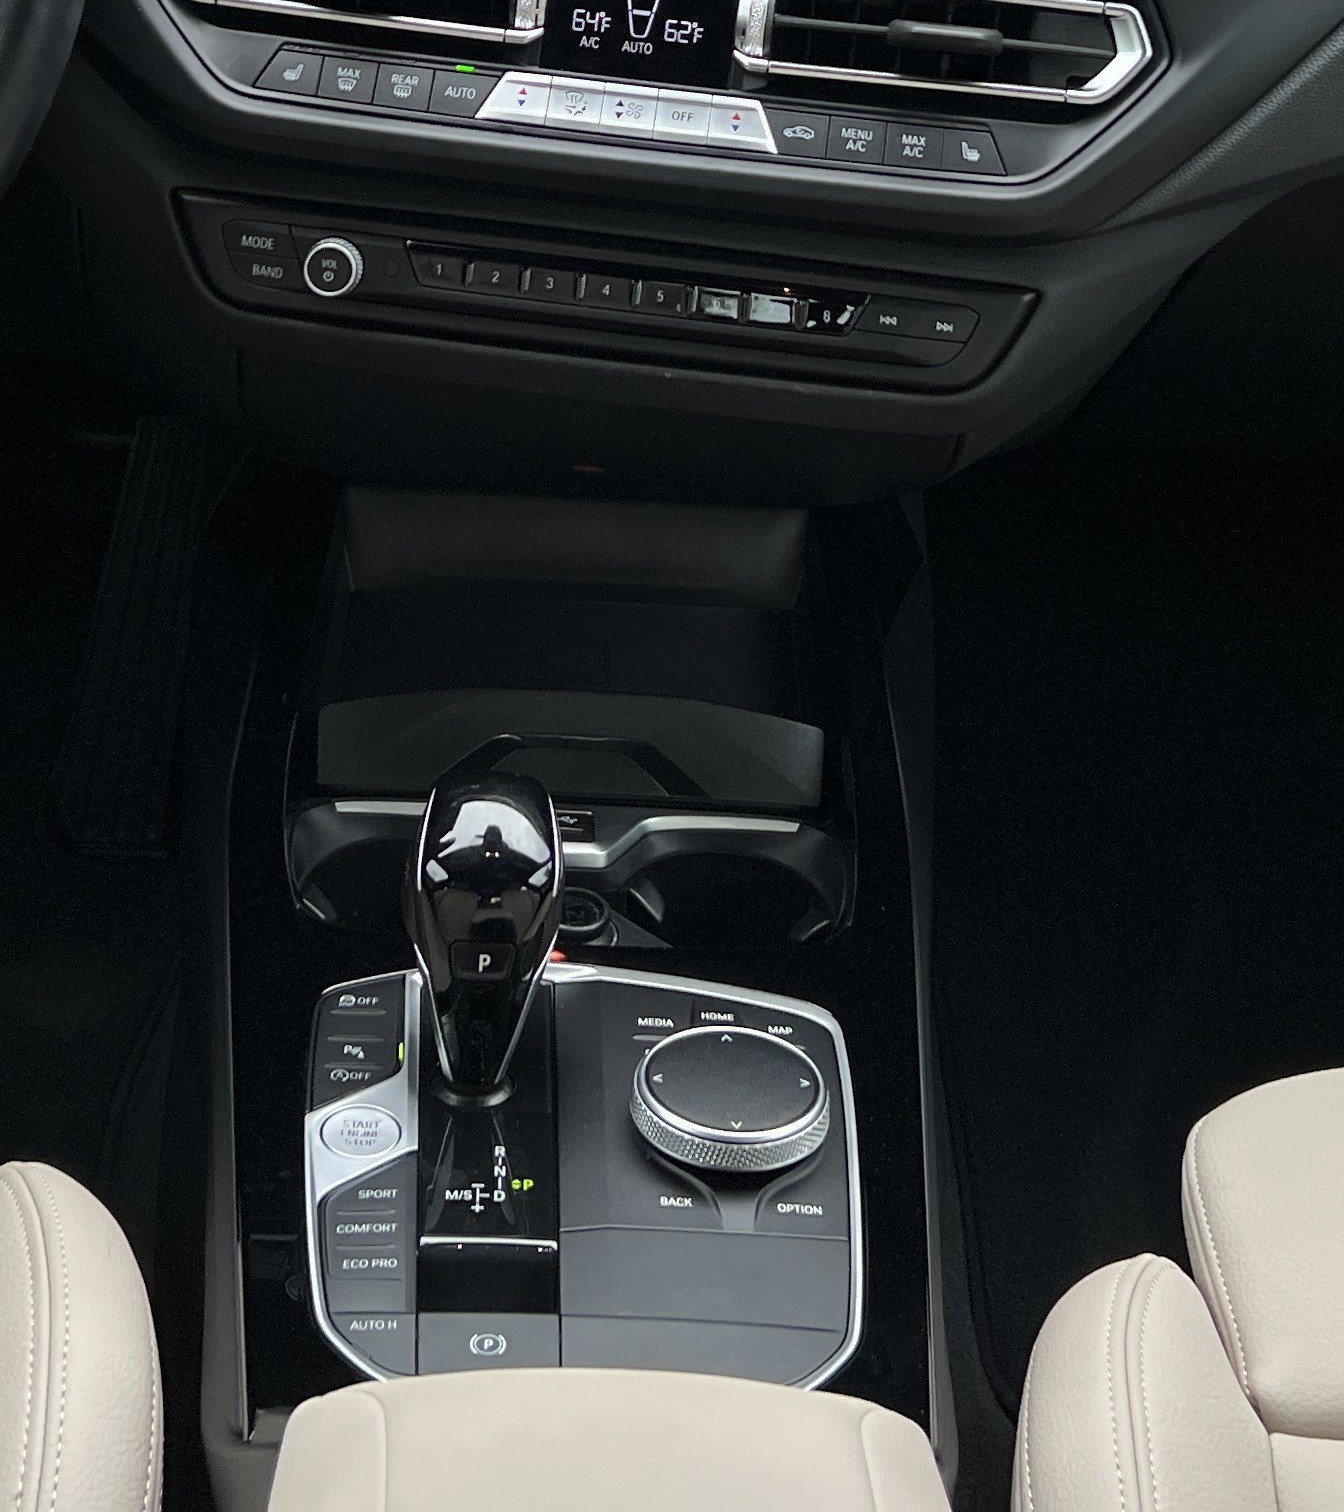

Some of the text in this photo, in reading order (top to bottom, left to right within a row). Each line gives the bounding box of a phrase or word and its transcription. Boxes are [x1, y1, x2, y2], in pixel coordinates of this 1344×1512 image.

[579, 36, 600, 49] A/C
[622, 41, 653, 55] AUTO
[337, 66, 361, 79] MAX
[390, 73, 419, 86] REAR
[444, 86, 476, 100] AUTO
[671, 110, 694, 122] OFF
[841, 127, 873, 142] MENU
[902, 134, 926, 147] MAX
[846, 139, 866, 153] A/C
[903, 145, 923, 158] A/C
[241, 235, 275, 251] MODE
[321, 258, 338, 270] VOL
[436, 263, 442, 276] 1
[251, 264, 283, 280] BAND
[491, 271, 499, 284] 2
[546, 277, 554, 289] 3
[602, 283, 610, 296] 4
[657, 290, 664, 303] 5
[822, 310, 830, 323] 8
[478, 953, 491, 972] P
[357, 996, 379, 1005] OFF
[637, 1017, 674, 1028] MEDIA
[701, 1012, 734, 1021] HOME
[768, 1025, 793, 1035] MAP
[349, 1071, 371, 1081] OFF
[494, 1145, 505, 1157] R
[494, 1165, 506, 1177] N
[523, 1179, 534, 1191] P
[358, 1189, 397, 1199] SPORT
[445, 1190, 472, 1201] M/S
[494, 1190, 506, 1202] D
[660, 1196, 693, 1207] BACK
[777, 1203, 823, 1215] OPTION
[336, 1223, 397, 1234] COMFORT
[342, 1258, 398, 1269] ECO PRO
[350, 1319, 397, 1331] AUTO H
